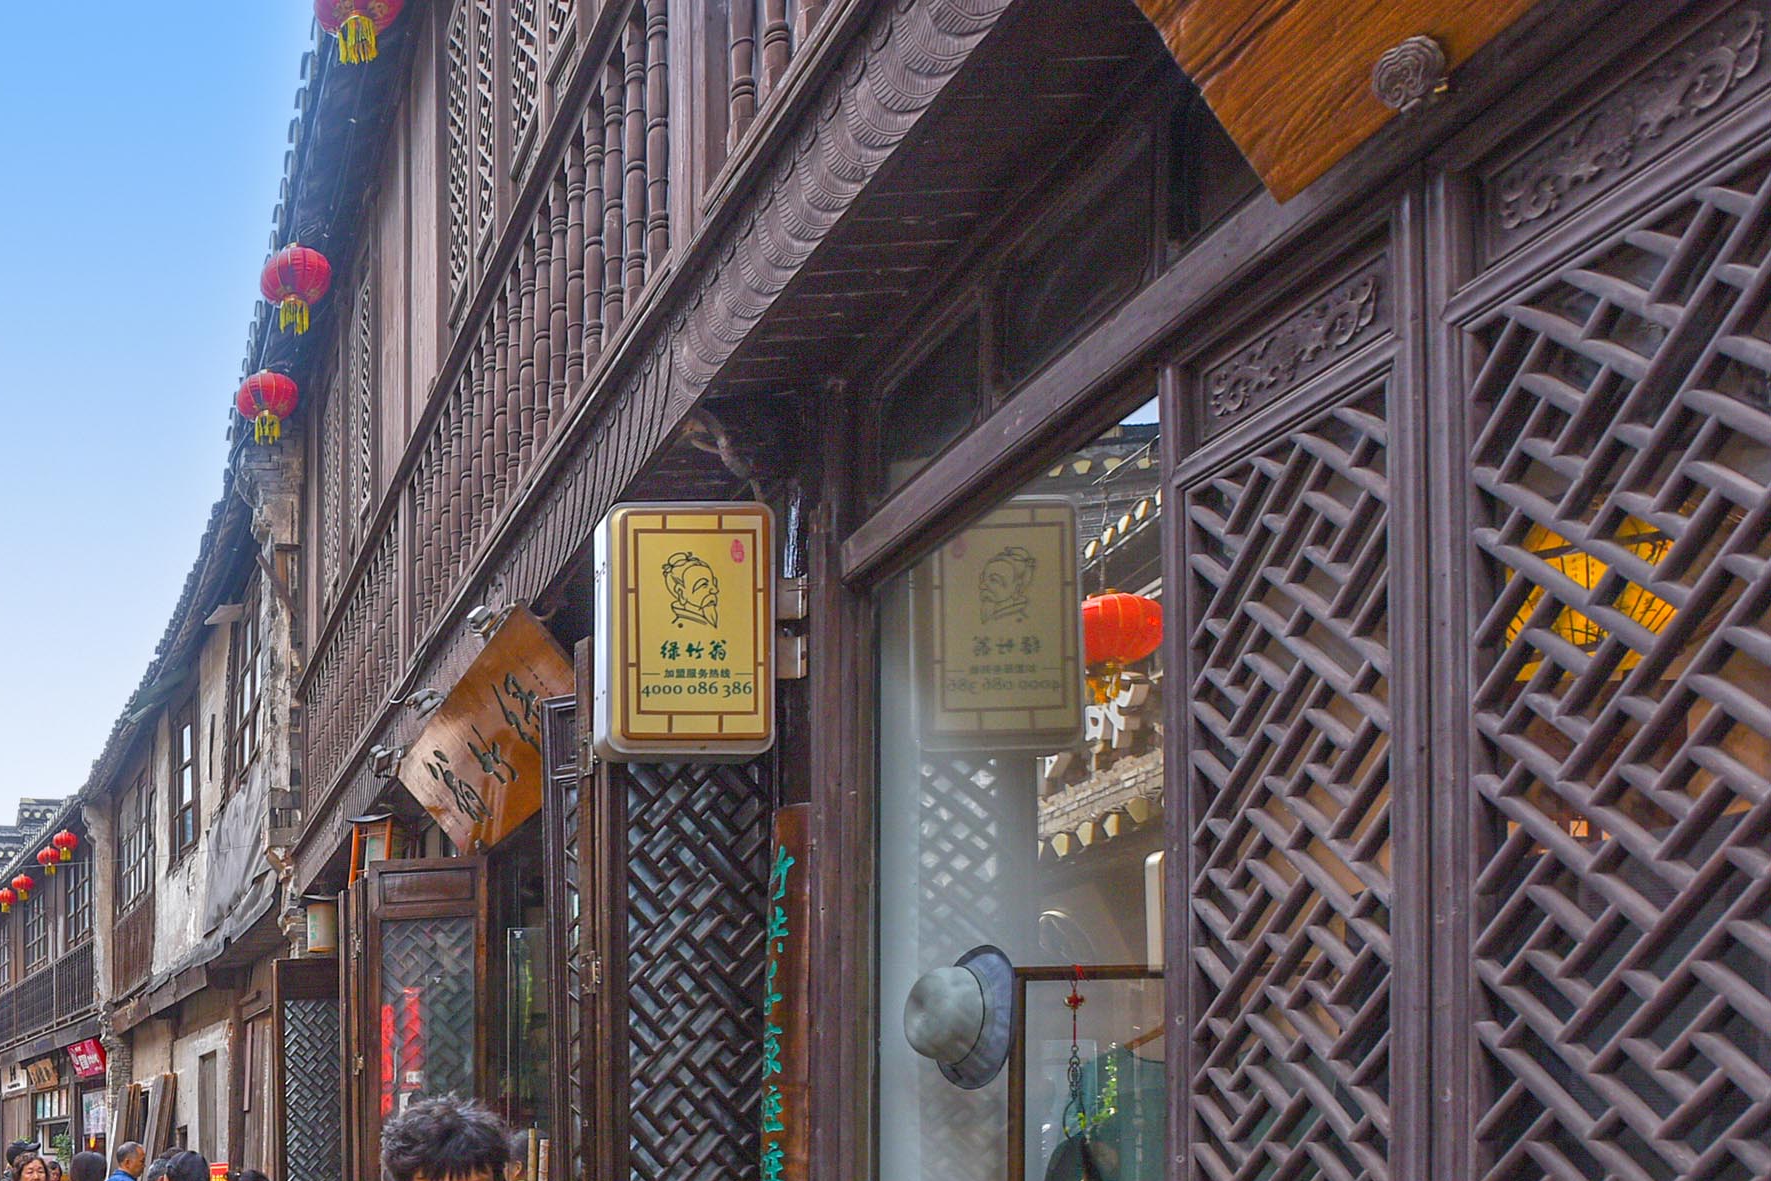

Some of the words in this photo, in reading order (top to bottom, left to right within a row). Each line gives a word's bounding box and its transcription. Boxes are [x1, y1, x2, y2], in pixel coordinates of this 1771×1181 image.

[660, 640, 727, 661] 绿竹翁
[664, 668, 731, 679] 加盟服务热线
[642, 684, 683, 697] 4000
[687, 681, 718, 694] 086
[722, 681, 752, 697] 386
